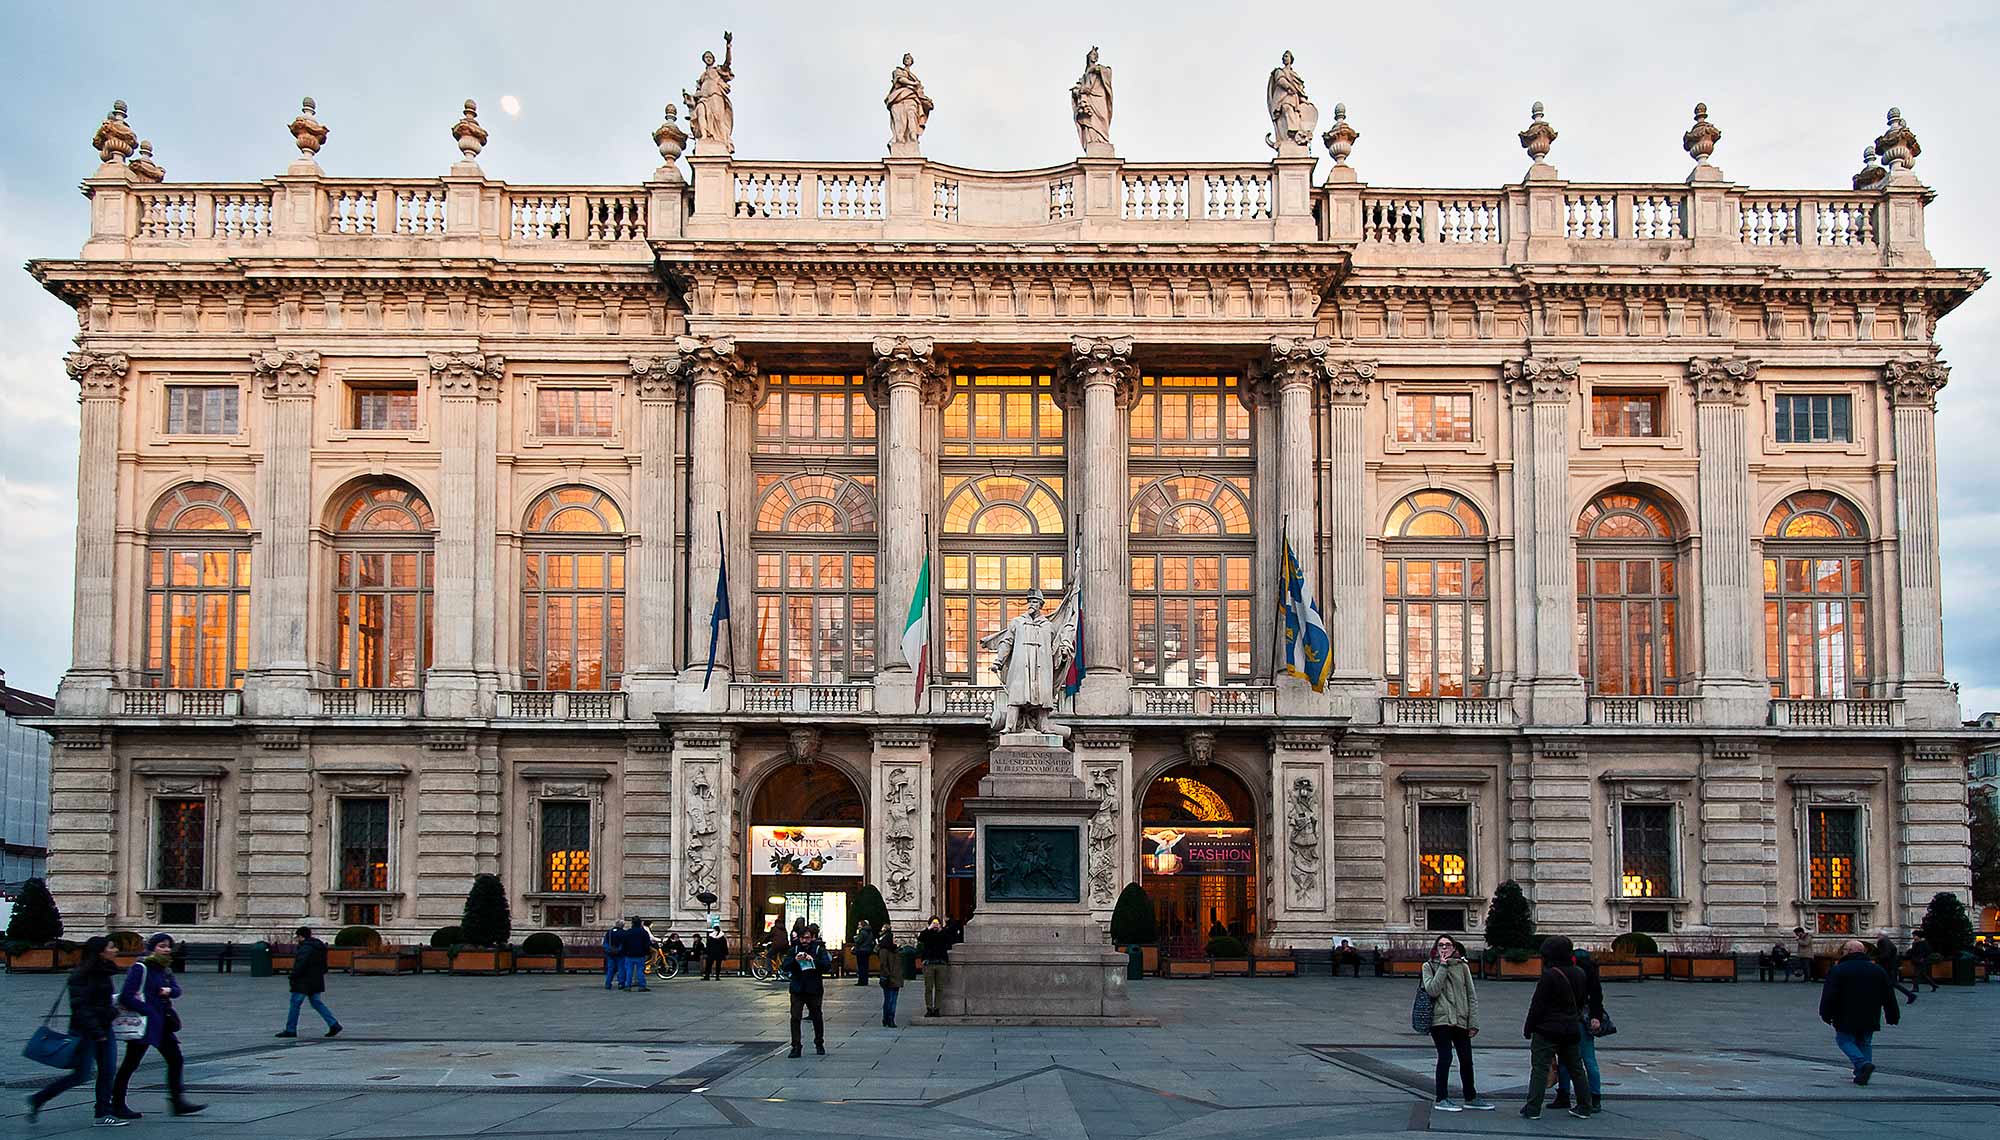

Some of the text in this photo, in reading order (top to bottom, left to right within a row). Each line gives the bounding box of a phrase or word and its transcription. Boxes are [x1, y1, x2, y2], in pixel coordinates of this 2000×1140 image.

[762, 839, 832, 848] ECCENTRICA
[775, 848, 822, 857] NATURA
[1189, 849, 1251, 860] FASHION
